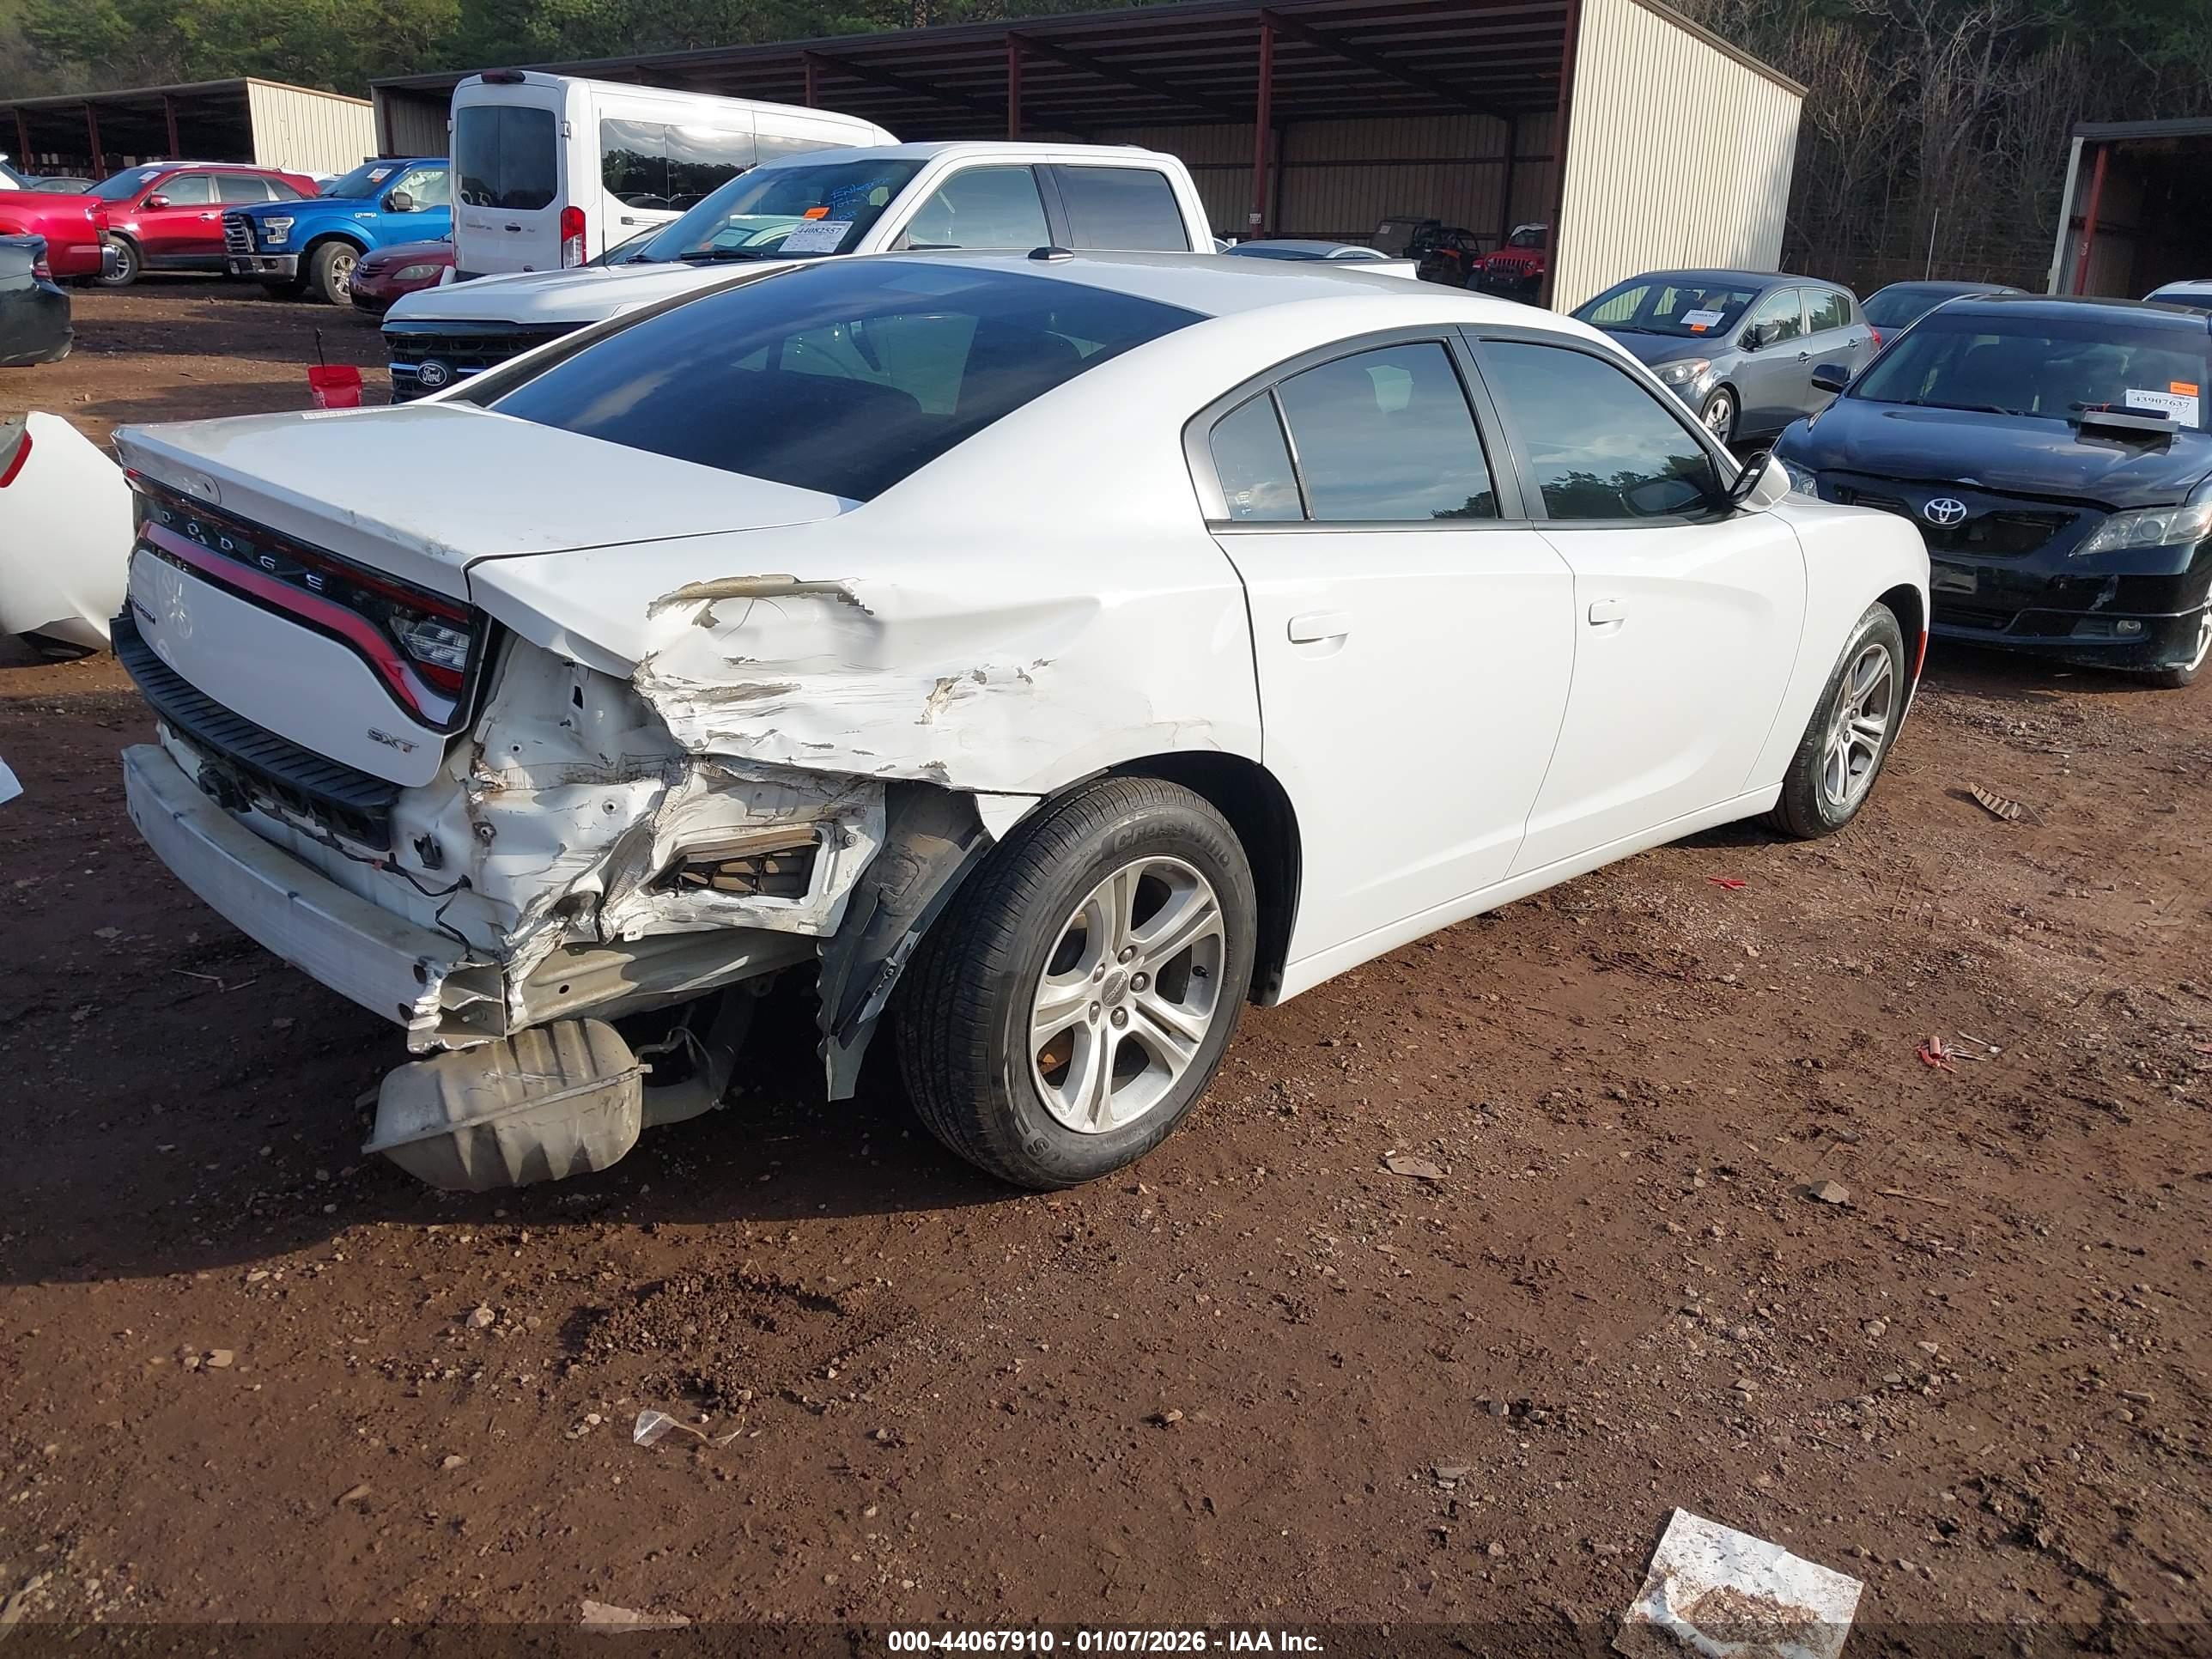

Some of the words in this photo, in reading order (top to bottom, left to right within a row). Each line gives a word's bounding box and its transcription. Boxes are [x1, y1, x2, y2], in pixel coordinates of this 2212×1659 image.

[422, 365, 442, 383] Ford
[2133, 396, 2191, 408] 43907637
[161, 509, 324, 592] DODGE
[367, 726, 420, 754] SXT
